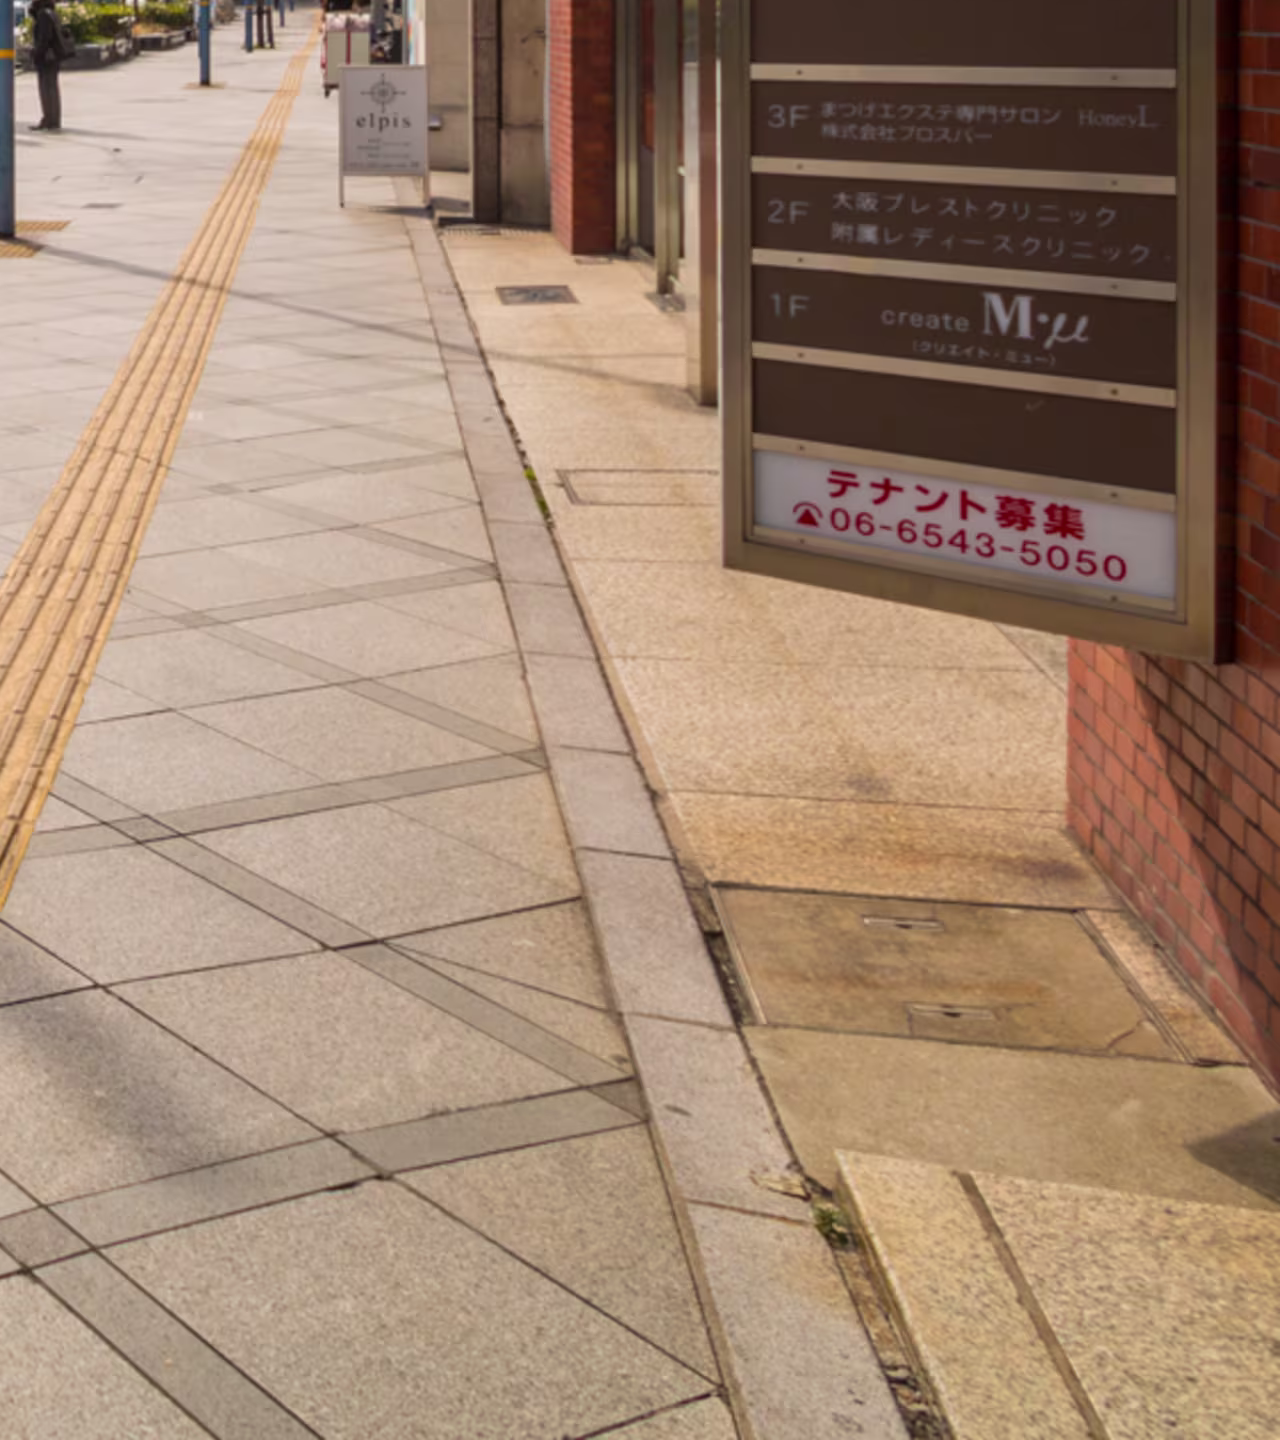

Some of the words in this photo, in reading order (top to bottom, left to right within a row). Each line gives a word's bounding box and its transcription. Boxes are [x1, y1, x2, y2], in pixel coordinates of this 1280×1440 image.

[355, 112, 412, 134] elpis
[766, 103, 812, 129] 3F
[766, 199, 811, 226] 2F
[831, 190, 1119, 228] 大阪ブレストクリニック
[829, 221, 1152, 266] 附属レディースクリニック
[768, 293, 811, 320] 1F
[880, 309, 970, 333] create
[825, 469, 1086, 541] テナント募集
[829, 506, 1129, 582] 06-6543-5050
